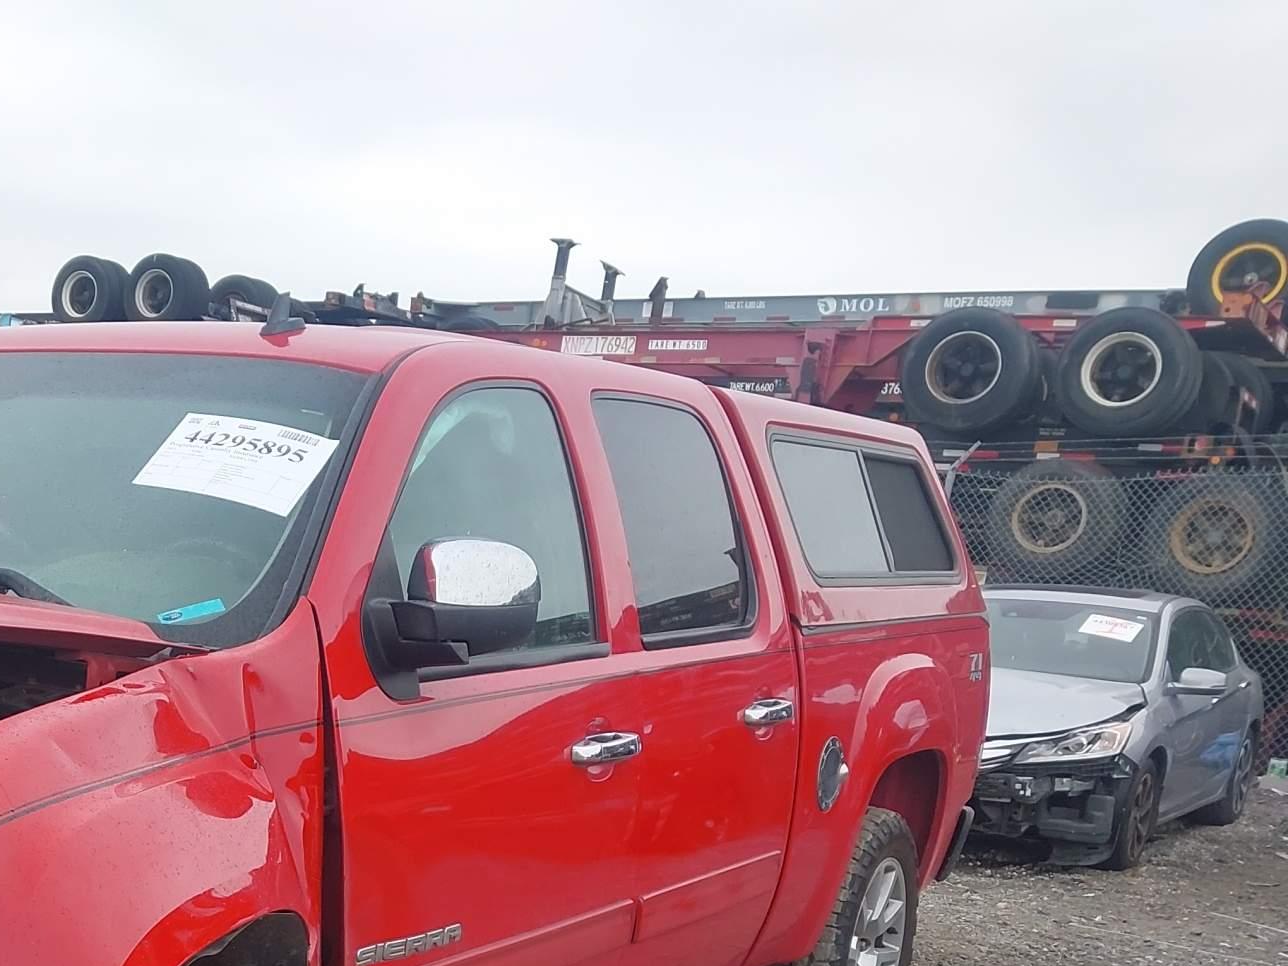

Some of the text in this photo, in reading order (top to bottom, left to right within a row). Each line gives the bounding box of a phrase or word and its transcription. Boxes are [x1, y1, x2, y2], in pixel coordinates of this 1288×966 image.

[840, 297, 890, 312] MOL
[944, 296, 975, 308] MOFZ
[185, 430, 309, 464] 44295895
